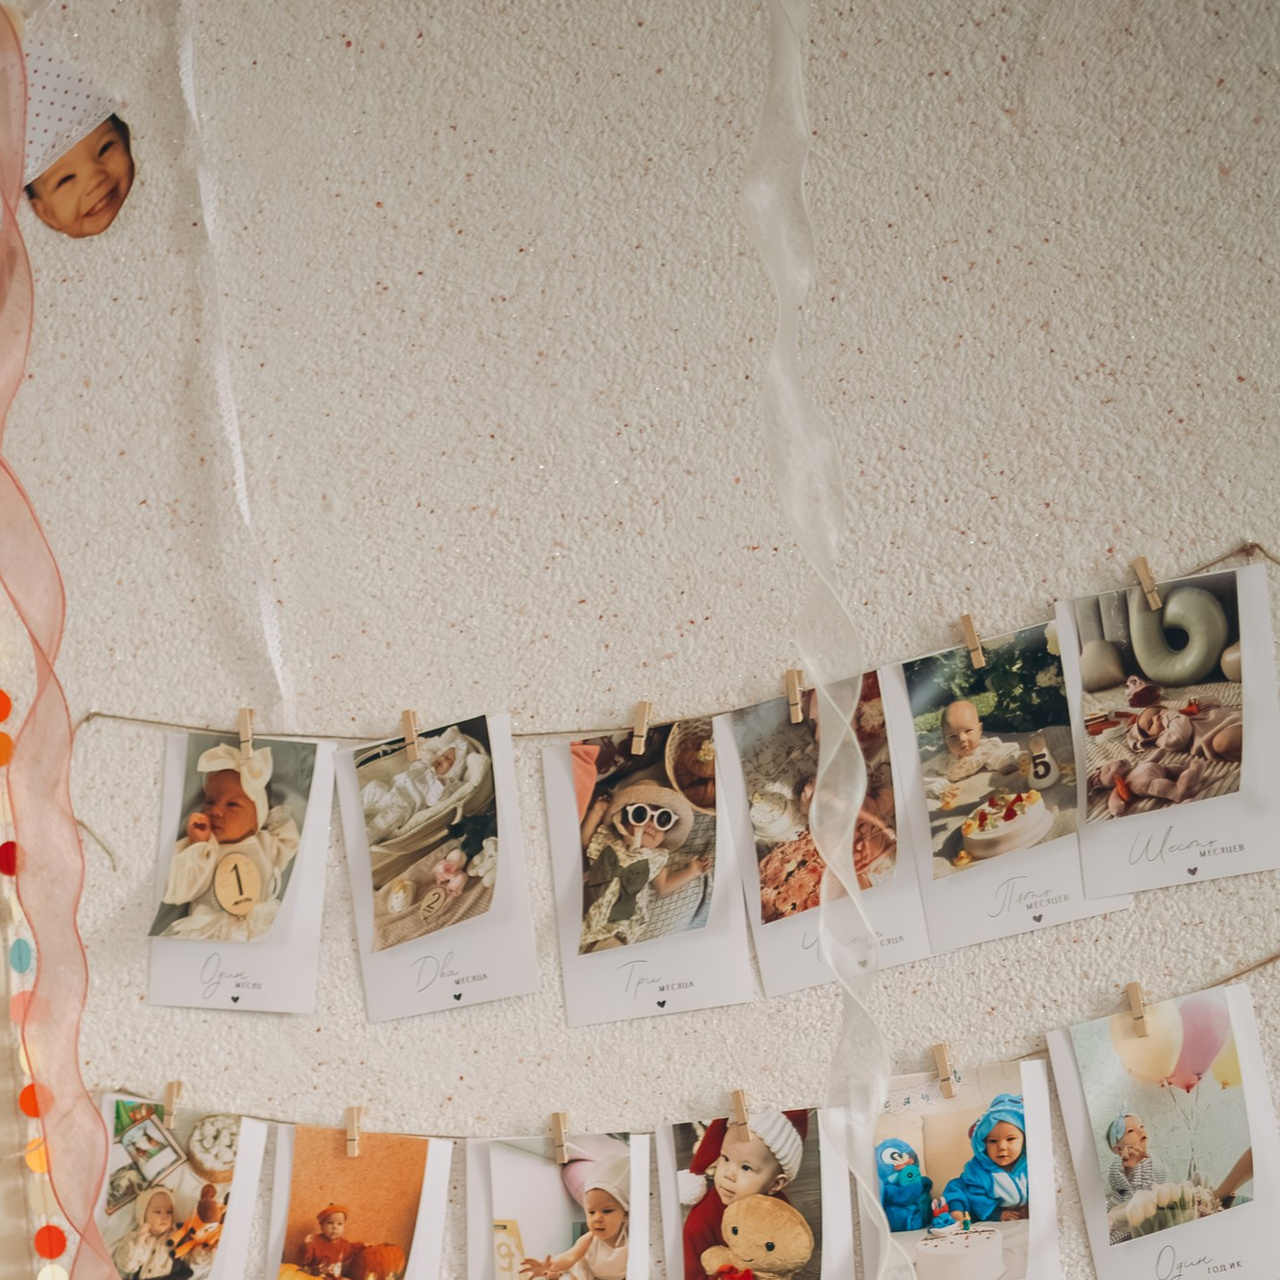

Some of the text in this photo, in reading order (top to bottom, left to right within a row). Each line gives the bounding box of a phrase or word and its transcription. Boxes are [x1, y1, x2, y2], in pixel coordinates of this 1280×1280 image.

[1032, 753, 1051, 780] 5
[1128, 825, 1217, 866] Шесть
[1199, 844, 1245, 858] МЕСЯЦЕВ
[1026, 894, 1070, 910] МЕСЯЦЕВ
[410, 950, 460, 993] Два
[618, 960, 662, 1001] Три
